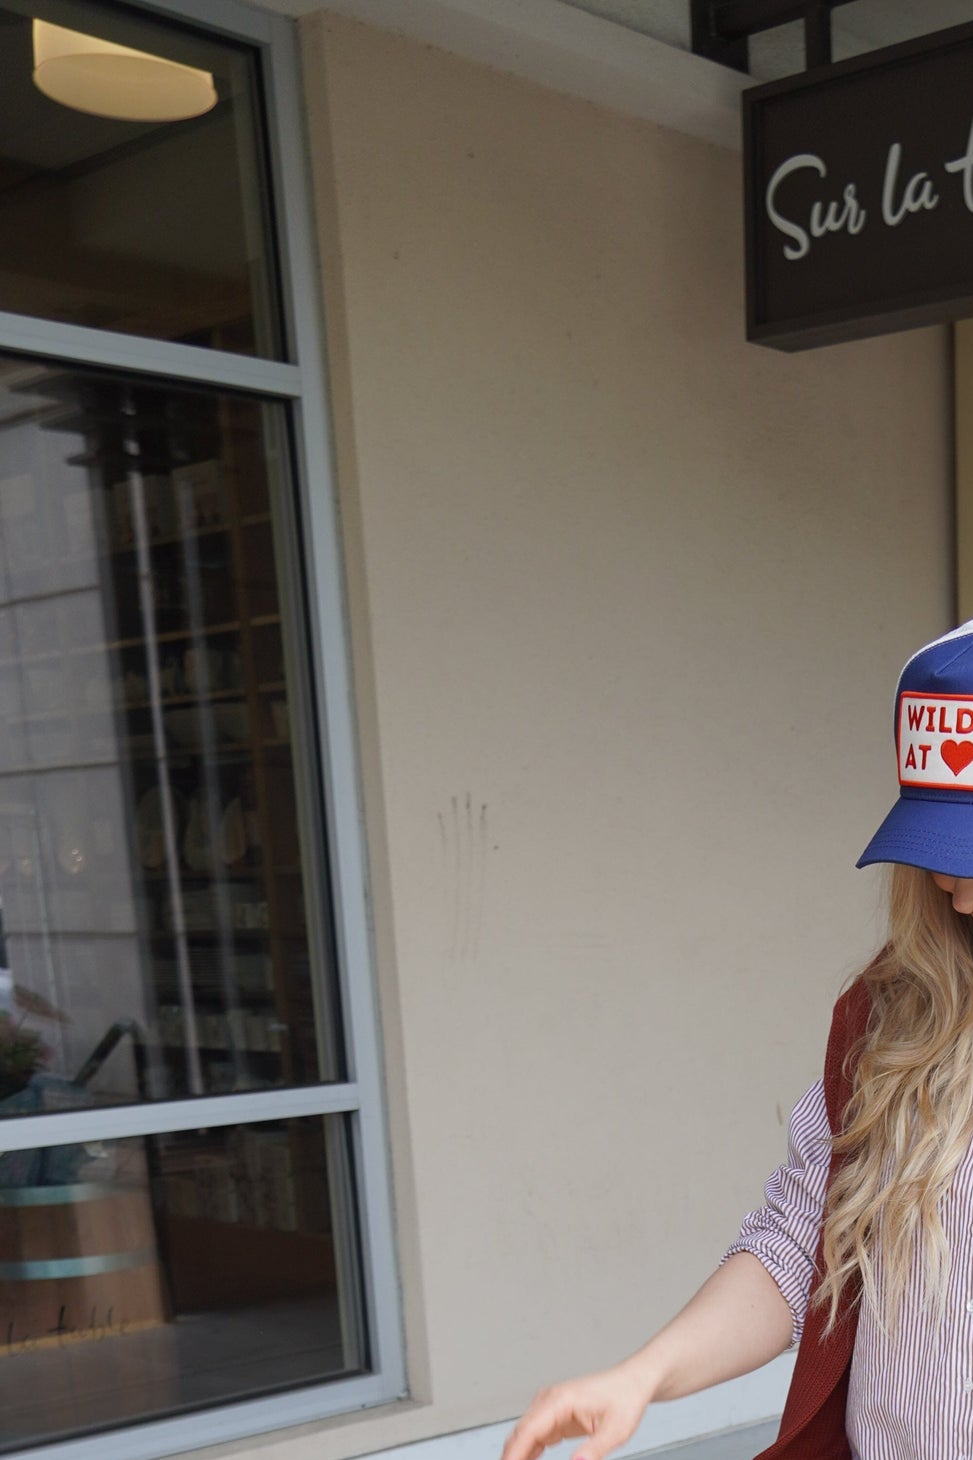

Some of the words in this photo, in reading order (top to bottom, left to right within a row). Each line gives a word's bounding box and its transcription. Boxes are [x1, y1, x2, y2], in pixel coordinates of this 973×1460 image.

[766, 153, 866, 260] Sur
[882, 142, 939, 226] la
[905, 743, 932, 770] AT
